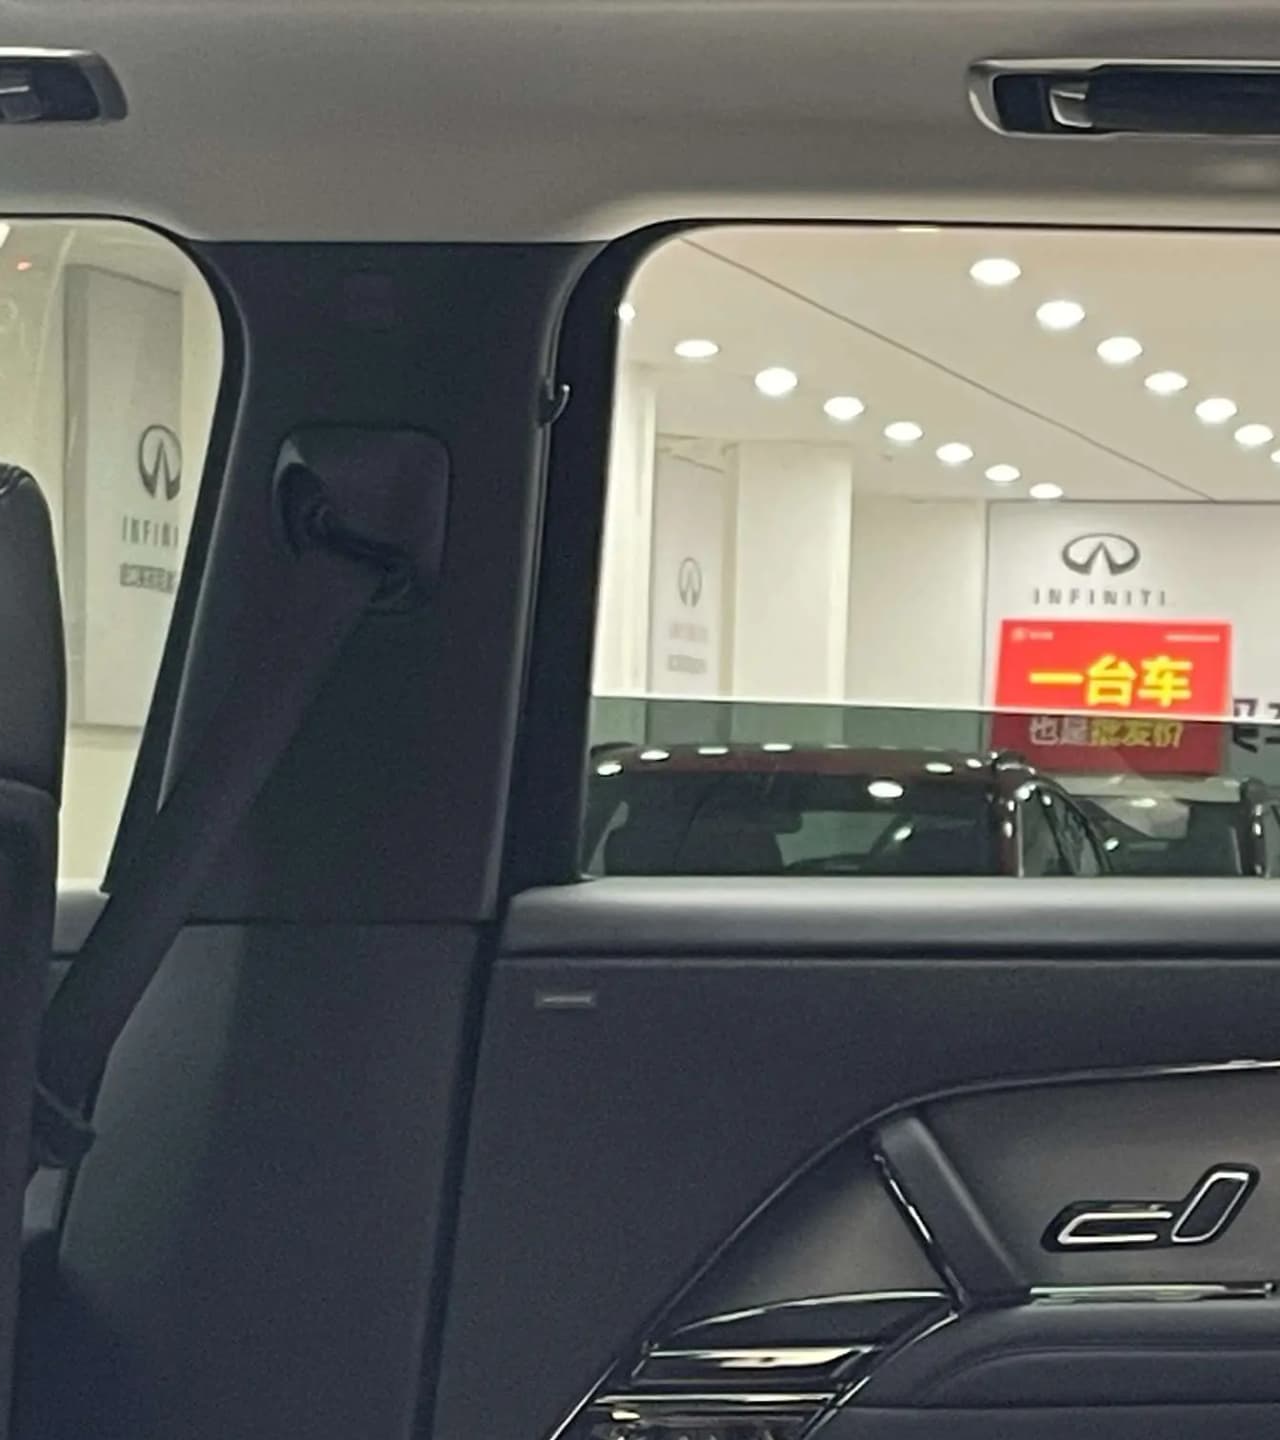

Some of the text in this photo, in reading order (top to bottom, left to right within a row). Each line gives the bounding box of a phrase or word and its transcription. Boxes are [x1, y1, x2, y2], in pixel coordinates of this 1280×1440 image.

[1033, 588, 1166, 607] INFINITI
[1028, 654, 1193, 708] 一台车
